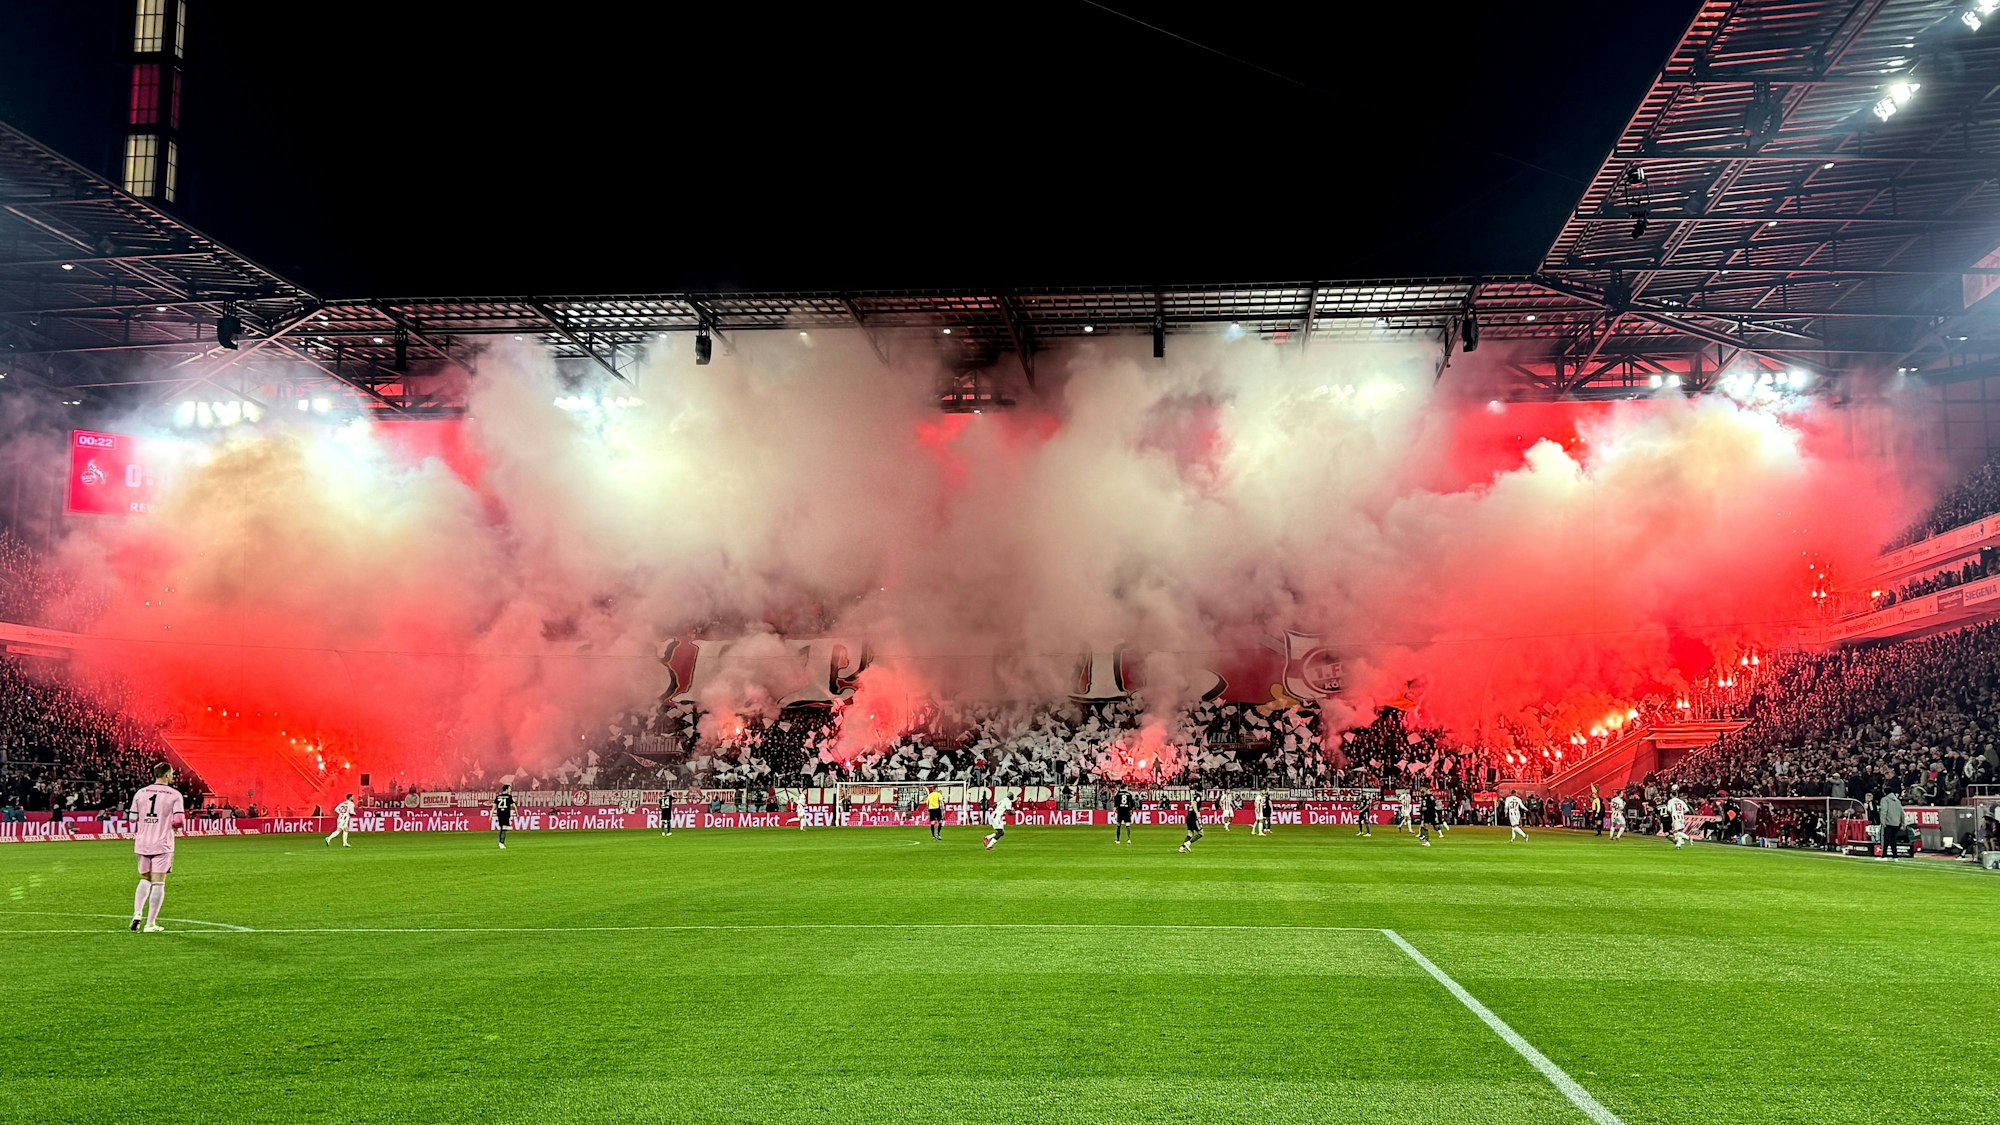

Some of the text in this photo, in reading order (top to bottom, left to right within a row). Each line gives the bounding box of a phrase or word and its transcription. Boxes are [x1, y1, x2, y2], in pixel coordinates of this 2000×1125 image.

[79, 436, 112, 447] 00:22
[130, 502, 158, 513] REW
[146, 794, 157, 817] 1
[1121, 794, 1127, 804] 8
[350, 816, 469, 832] EWE Dein Markt
[549, 815, 578, 830] Dein
[582, 814, 625, 830] Markt
[704, 813, 734, 829] Dein
[738, 812, 780, 828] Markt
[895, 810, 930, 826] Mark
[1015, 810, 1044, 825] Dein
[1158, 810, 1186, 824] Dein
[1269, 811, 1303, 825] EWE
[1309, 810, 1340, 824] Dein
[1925, 811, 1940, 824] REWE
[273, 818, 314, 833] Markt
